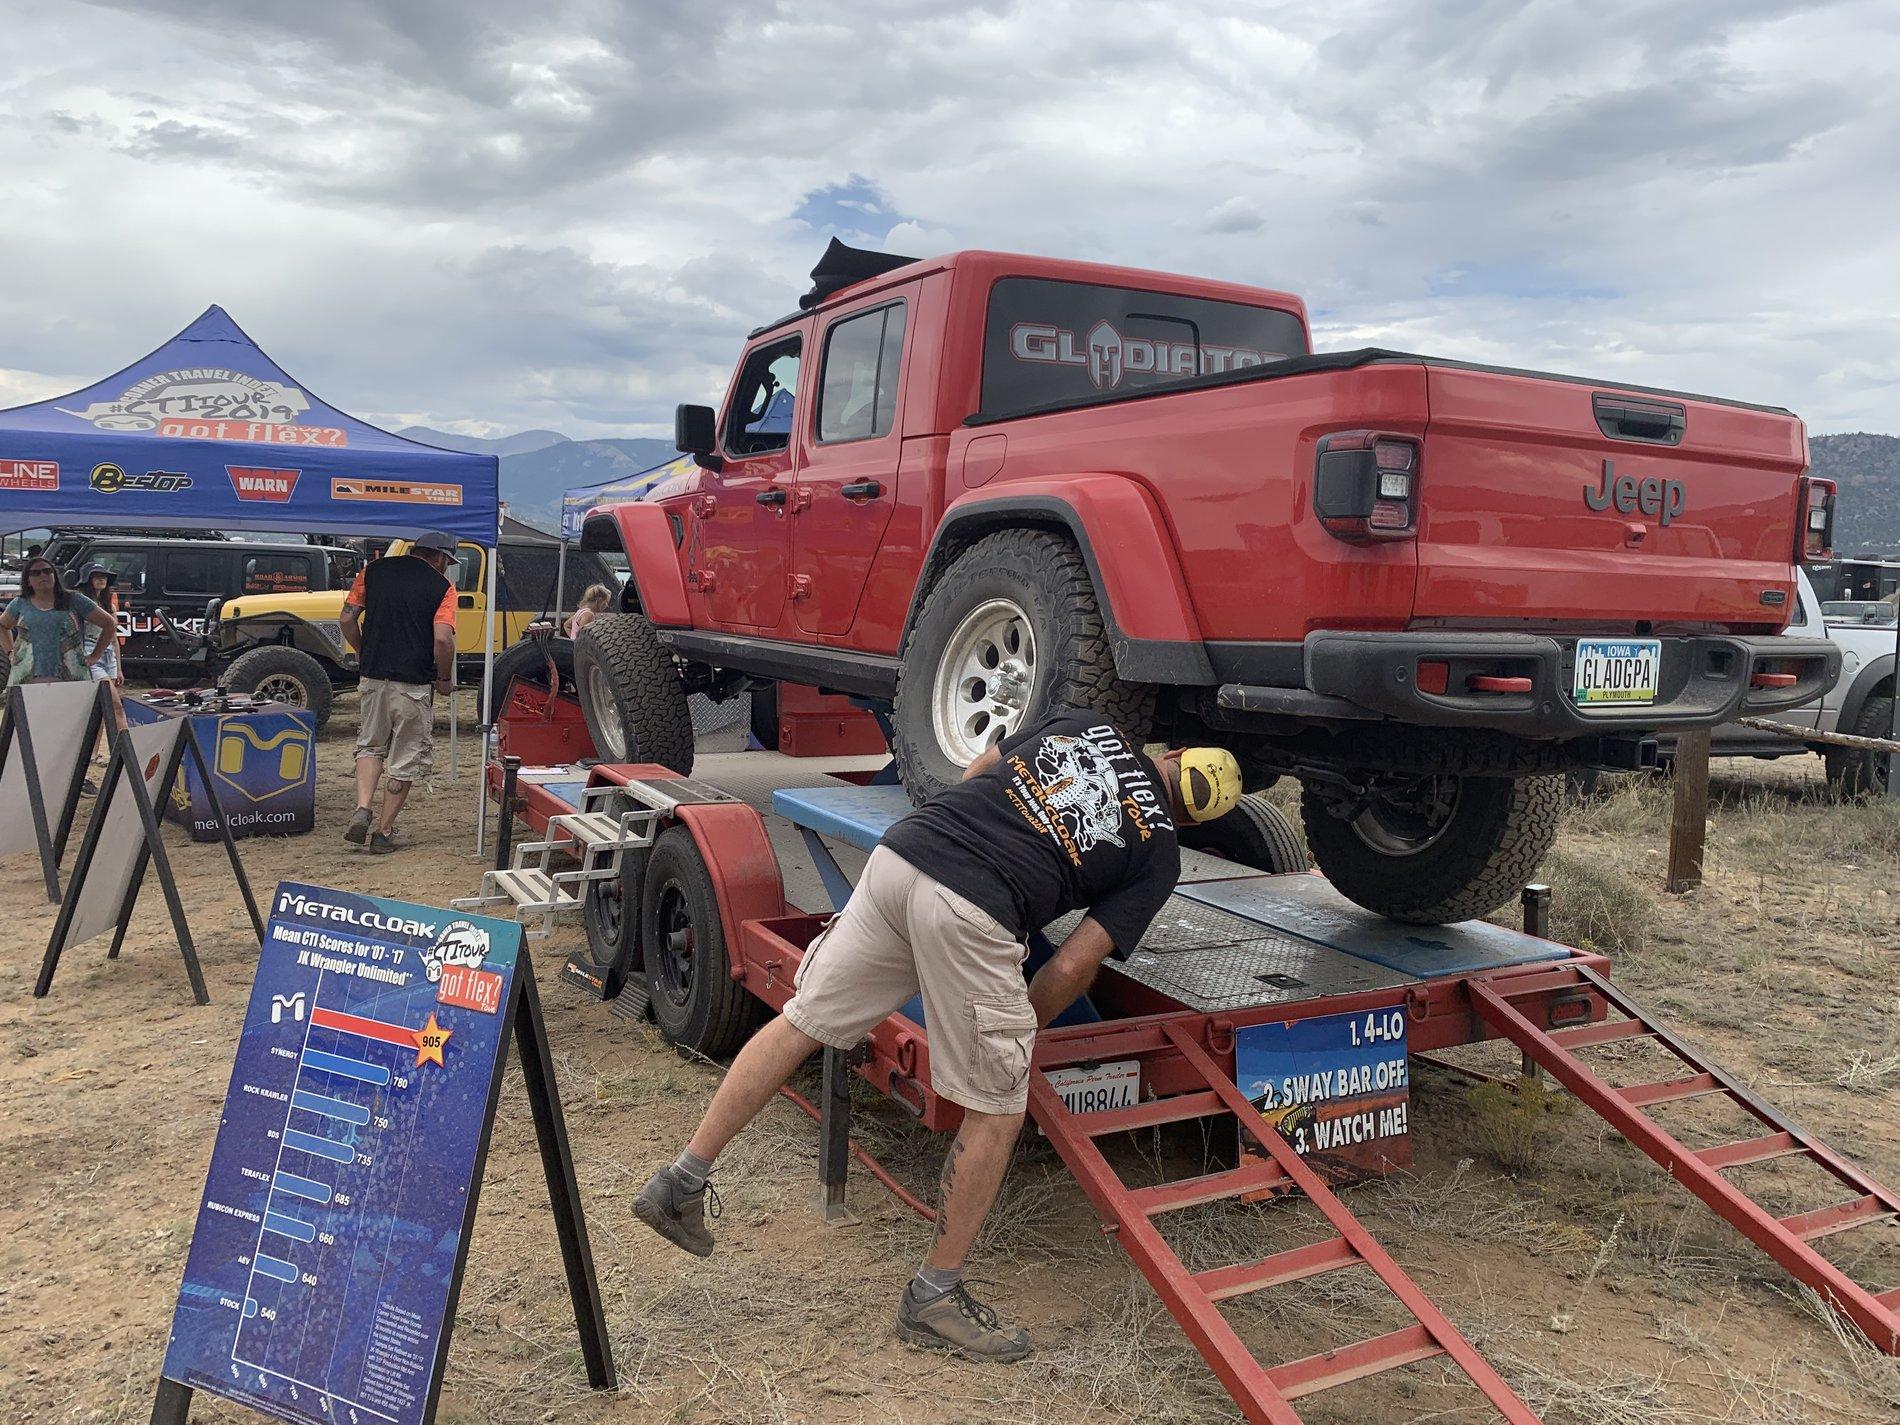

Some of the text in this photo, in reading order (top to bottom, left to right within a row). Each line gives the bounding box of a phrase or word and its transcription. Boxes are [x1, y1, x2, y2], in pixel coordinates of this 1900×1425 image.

[170, 368, 232, 382] TRAVEL
[200, 404, 293, 420] 2019
[162, 421, 229, 439] got
[247, 422, 343, 446] flex?
[0, 478, 56, 488] WHEELS
[238, 476, 288, 493] WARN
[365, 485, 459, 497] MILESTAR
[1583, 459, 1686, 526] Jeep
[1607, 645, 1631, 657] IOWA
[1583, 658, 1650, 689] GLADGPA
[1602, 690, 1632, 699] PLYMOUTH
[1080, 724, 1174, 832] got flex?
[194, 810, 296, 830] metlcloak.com
[1122, 795, 1152, 842] TOUR
[272, 925, 301, 944] Mean
[301, 930, 319, 948] CTI
[318, 934, 352, 956] Scores
[353, 941, 369, 958] for
[296, 949, 309, 965] JK
[310, 952, 358, 977] Wrangler
[438, 970, 502, 1005] got flex?
[1350, 1011, 1404, 1046] 1. 4-LO
[422, 1035, 441, 1048] 905
[270, 1046, 298, 1060] SYNERGY
[392, 1076, 408, 1089] 780
[1263, 1059, 1405, 1110] 2. SWAY BAR OFF
[243, 1084, 288, 1102] ROCK KRAWLER
[373, 1116, 388, 1129] 750
[1295, 1102, 1408, 1155] 3. WATCH ME!
[267, 1129, 280, 1139] BDS
[356, 1153, 372, 1167] 735
[240, 1167, 271, 1182] TERAFLEX
[334, 1192, 350, 1206] 685
[206, 1201, 260, 1223] RUBICON EXPRESS
[318, 1232, 334, 1245] 660
[237, 1255, 251, 1266] AEV
[302, 1272, 317, 1287] 640
[219, 1297, 240, 1311] STOCK
[260, 1307, 277, 1321] 540
[230, 1363, 240, 1379] 500
[258, 1373, 268, 1389] 600
[289, 1384, 299, 1401] 700
[319, 1396, 328, 1413] 800
[348, 1408, 358, 1425] 900
